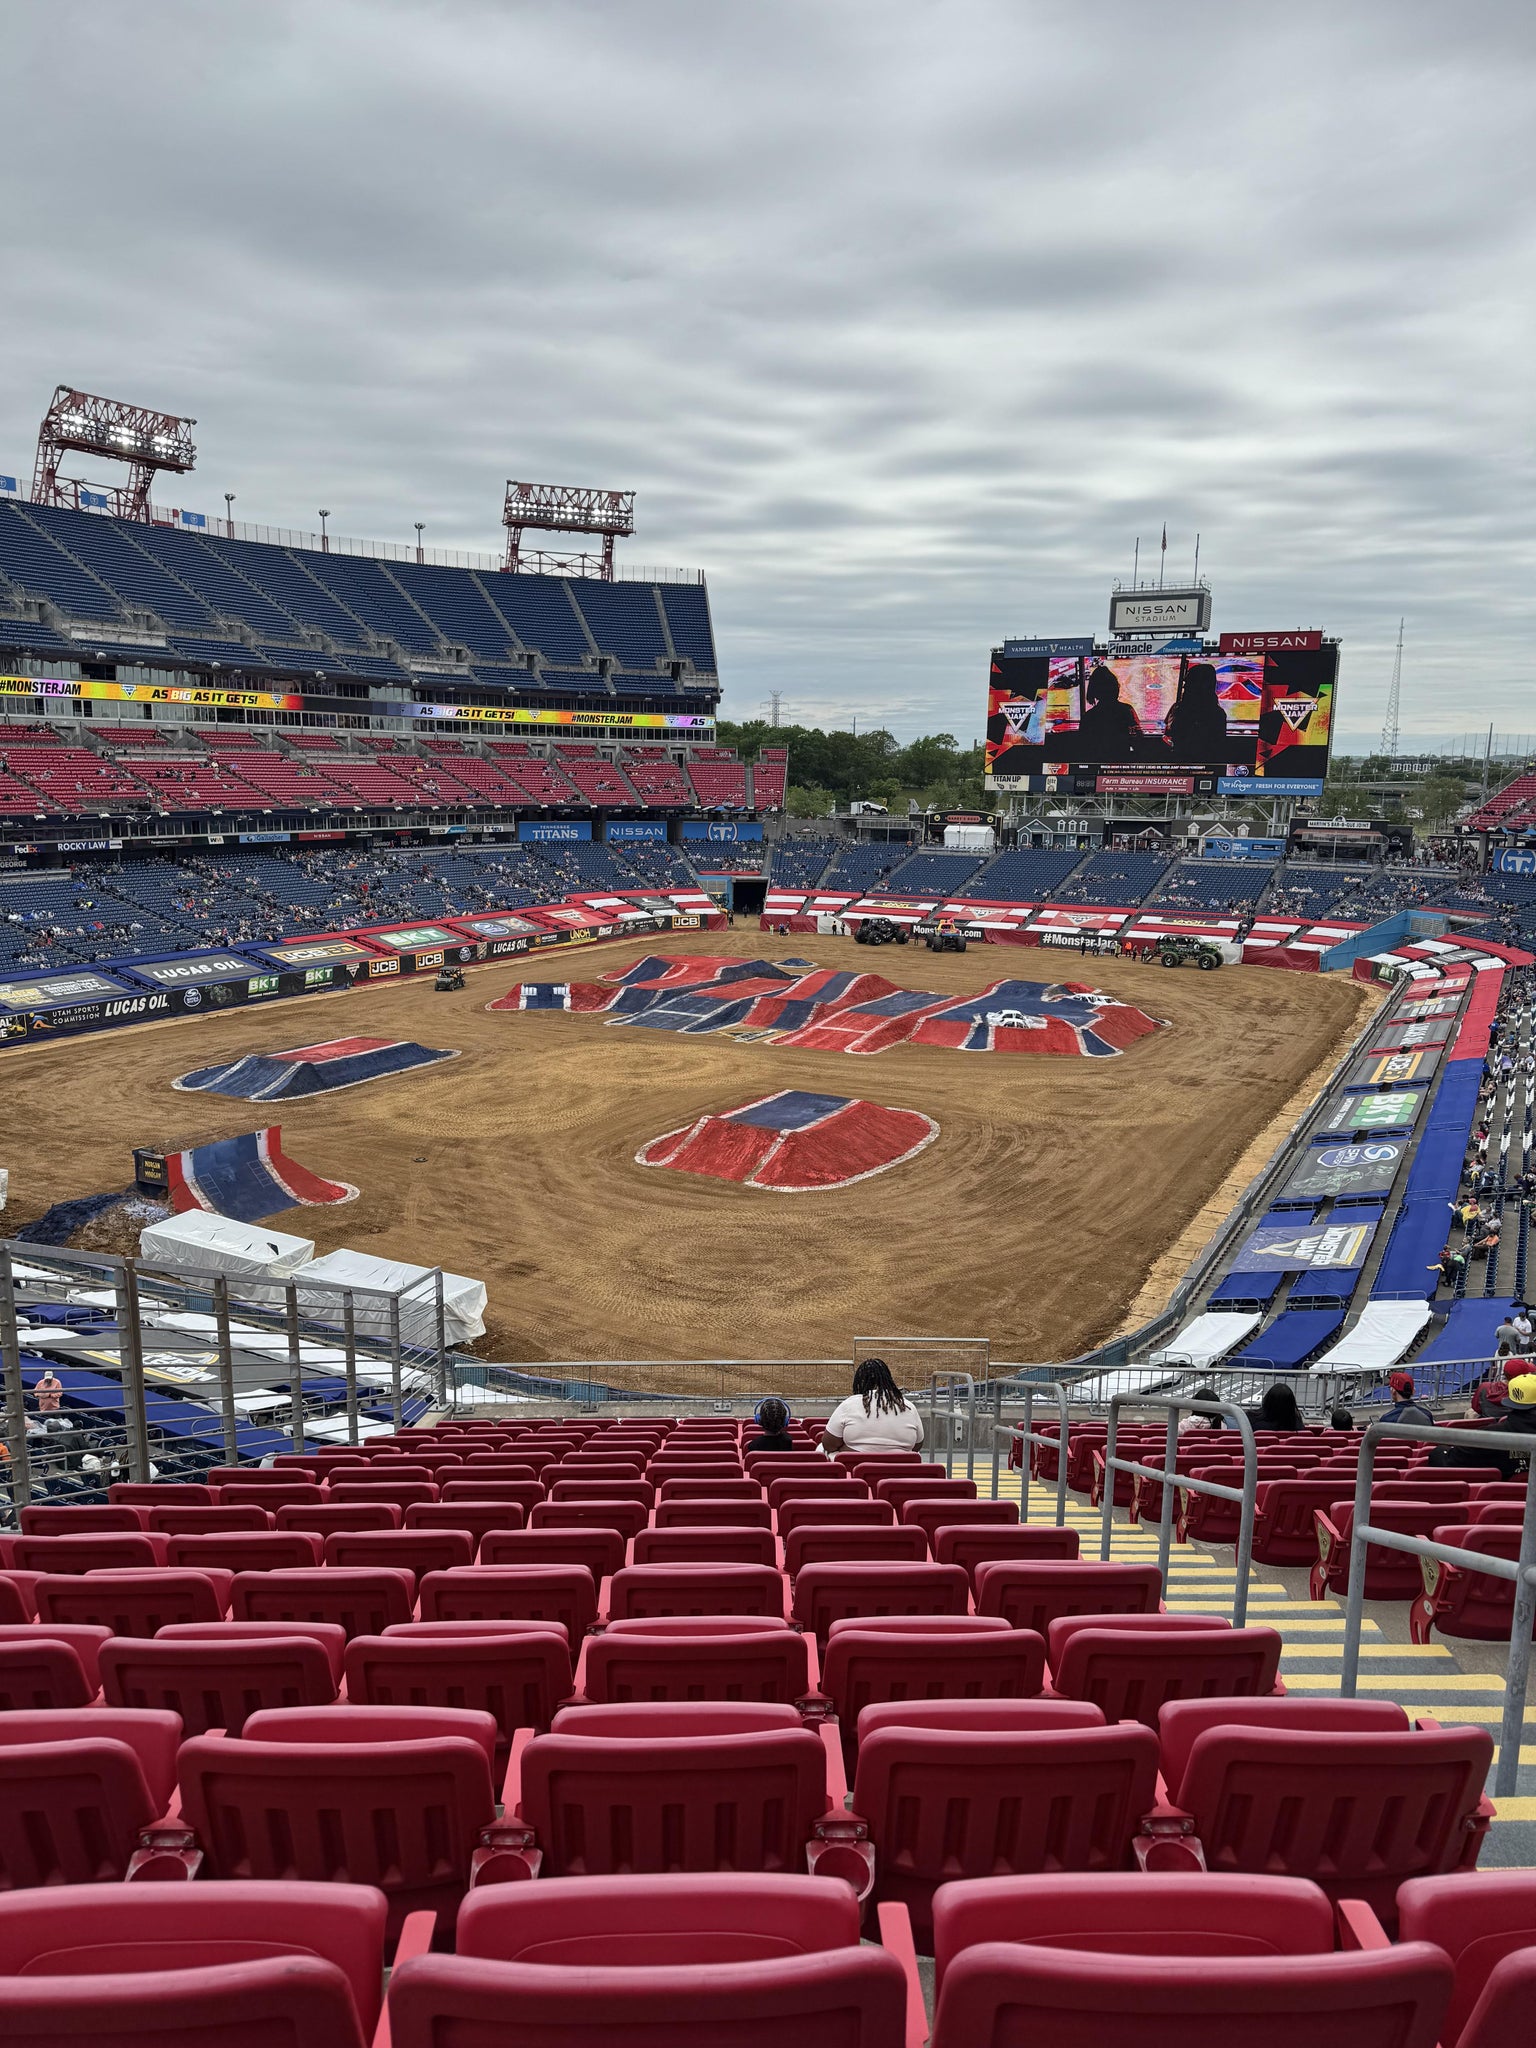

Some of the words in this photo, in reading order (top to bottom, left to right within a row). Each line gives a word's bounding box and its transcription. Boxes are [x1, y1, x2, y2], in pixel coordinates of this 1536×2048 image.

[1126, 605, 1187, 615] NISSAN
[1109, 642, 1153, 654] Pinnacle
[1232, 636, 1307, 648] NISSAN
[0, 680, 82, 696] #MONSTERJAM
[151, 689, 168, 699] AS
[170, 690, 192, 701] BIG
[193, 691, 210, 701] AS
[211, 692, 224, 702] IT
[225, 694, 259, 705] GETS!
[420, 707, 433, 715] AS
[455, 708, 470, 717] AS
[471, 709, 482, 718] IT
[484, 710, 515, 719] GETS!
[571, 714, 633, 724] #MONSTERJAM
[690, 718, 706, 726] AS
[993, 775, 1011, 783] TITAN
[1012, 775, 1021, 783] UP
[532, 830, 579, 839] TITANS
[610, 828, 664, 836] NISSAN
[14, 844, 38, 854] FedEx
[57, 842, 87, 852] ROCKY
[88, 841, 107, 850] LAW
[0, 860, 27, 869] GEORGE
[674, 917, 698, 926] JCB
[493, 940, 515, 954] LUCAS
[516, 938, 528, 949] OIL
[418, 953, 442, 967] JCB
[152, 964, 212, 979] LUCAS
[371, 960, 398, 973] JCB
[305, 968, 333, 983] BKT
[249, 977, 278, 991] BKT
[52, 1009, 71, 1018] UTAH
[74, 1005, 100, 1015] SPORTS
[105, 996, 147, 1017] LUCAS
[52, 1013, 100, 1025] COMMISSION
[1361, 1093, 1408, 1124] BKT
[1293, 1239, 1320, 1260] JAM
[1309, 1227, 1348, 1266] MONSTER
